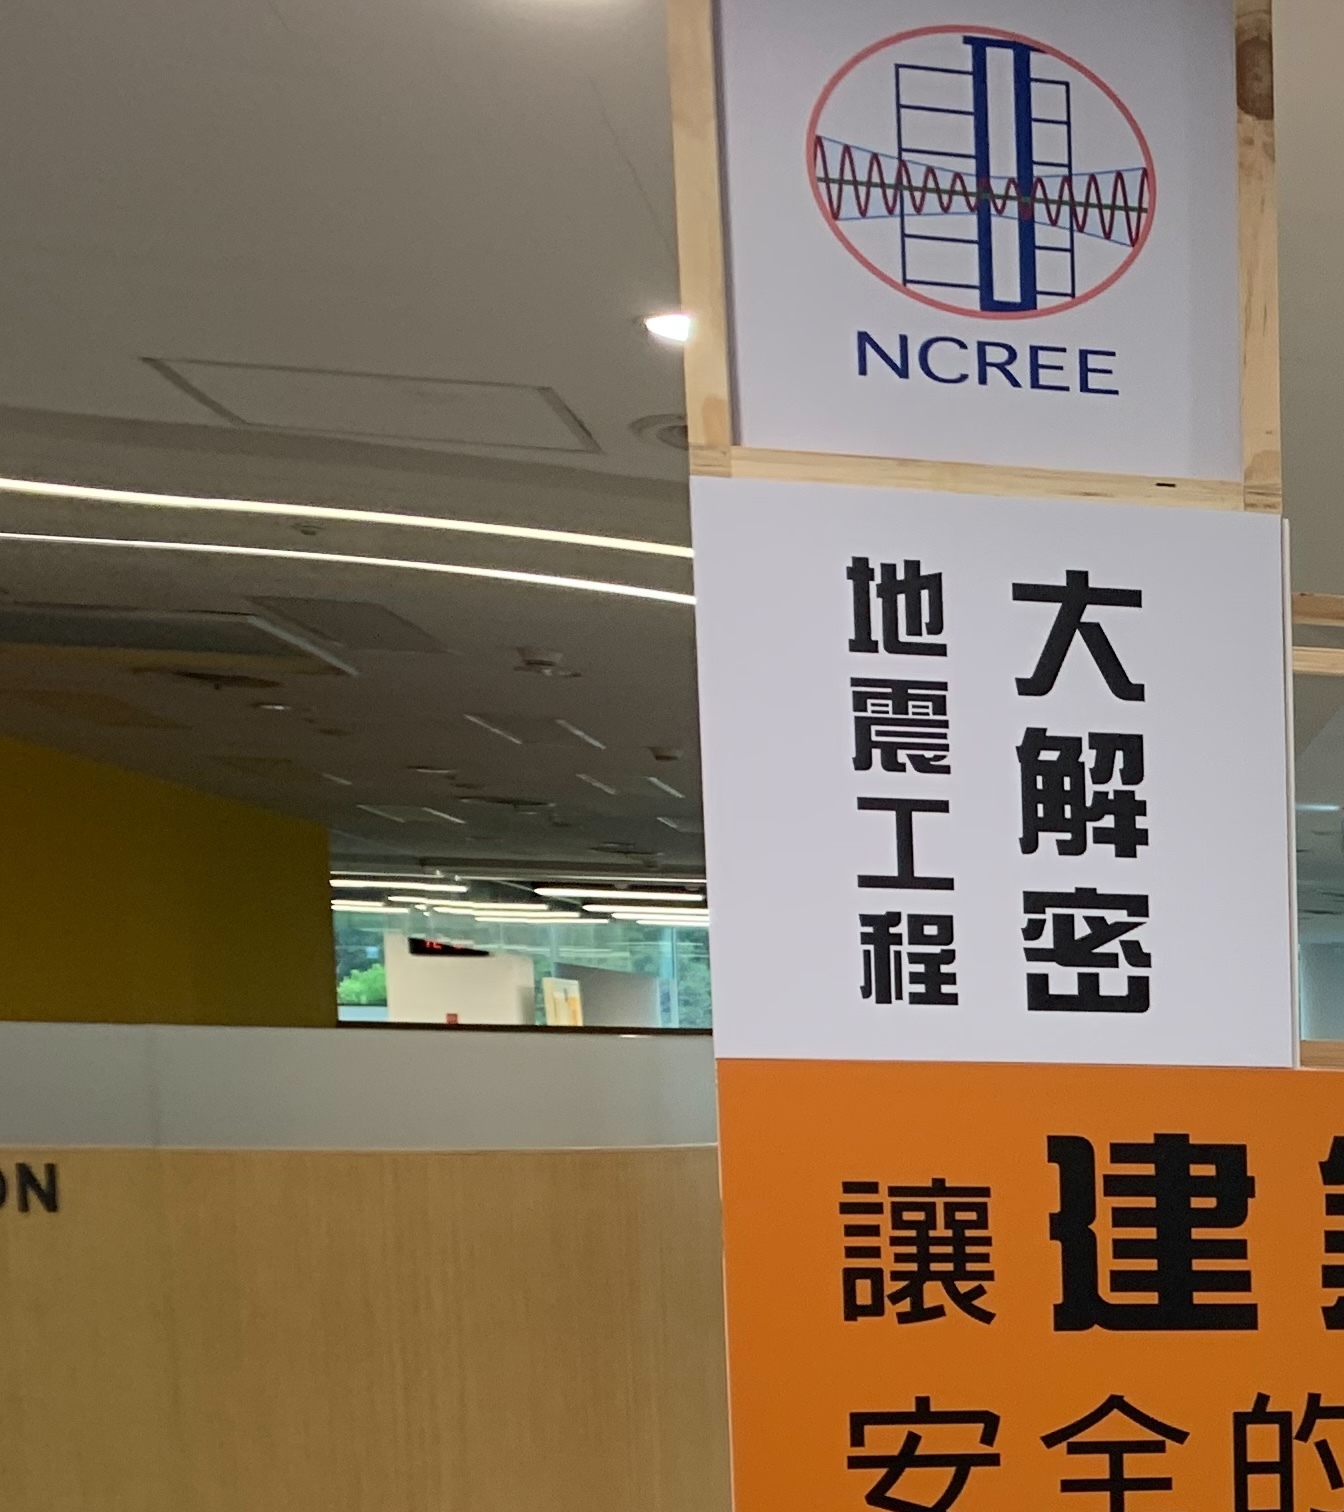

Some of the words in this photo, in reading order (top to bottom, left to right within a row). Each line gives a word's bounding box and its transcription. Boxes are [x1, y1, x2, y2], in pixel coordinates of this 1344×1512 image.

[857, 331, 1120, 397] NCREE
[846, 556, 959, 1006] 地震工程
[1011, 569, 1151, 1014] 大解密
[0, 1163, 58, 1213] N
